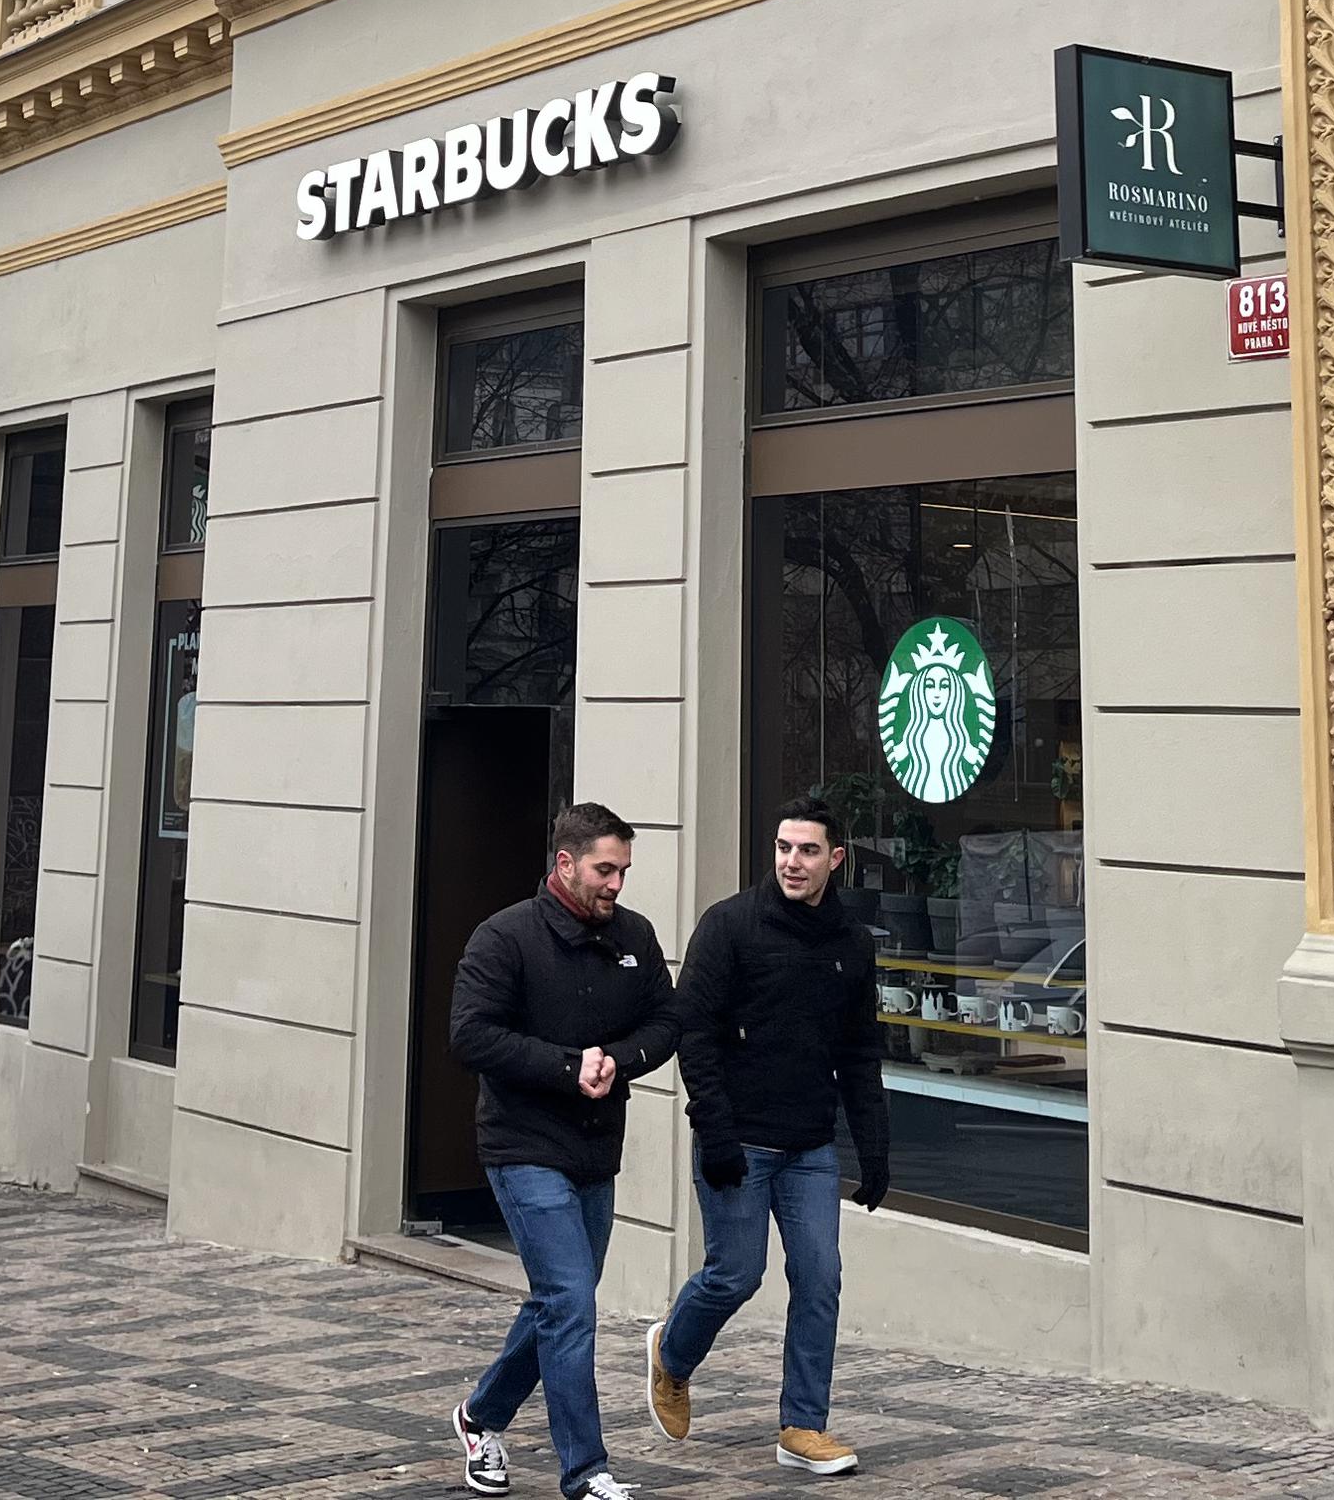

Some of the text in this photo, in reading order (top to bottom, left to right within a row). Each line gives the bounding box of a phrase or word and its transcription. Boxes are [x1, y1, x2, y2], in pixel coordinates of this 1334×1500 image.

[296, 71, 673, 241] STARBUCKS
[1108, 181, 1208, 213] ROSMARINO
[1109, 210, 1210, 232] KVĚTINOVÝ ATELIÉR
[1239, 281, 1286, 318] 813
[1238, 316, 1288, 334] NOVÉ MĚSTO
[1244, 334, 1284, 349] PRAHA 1
